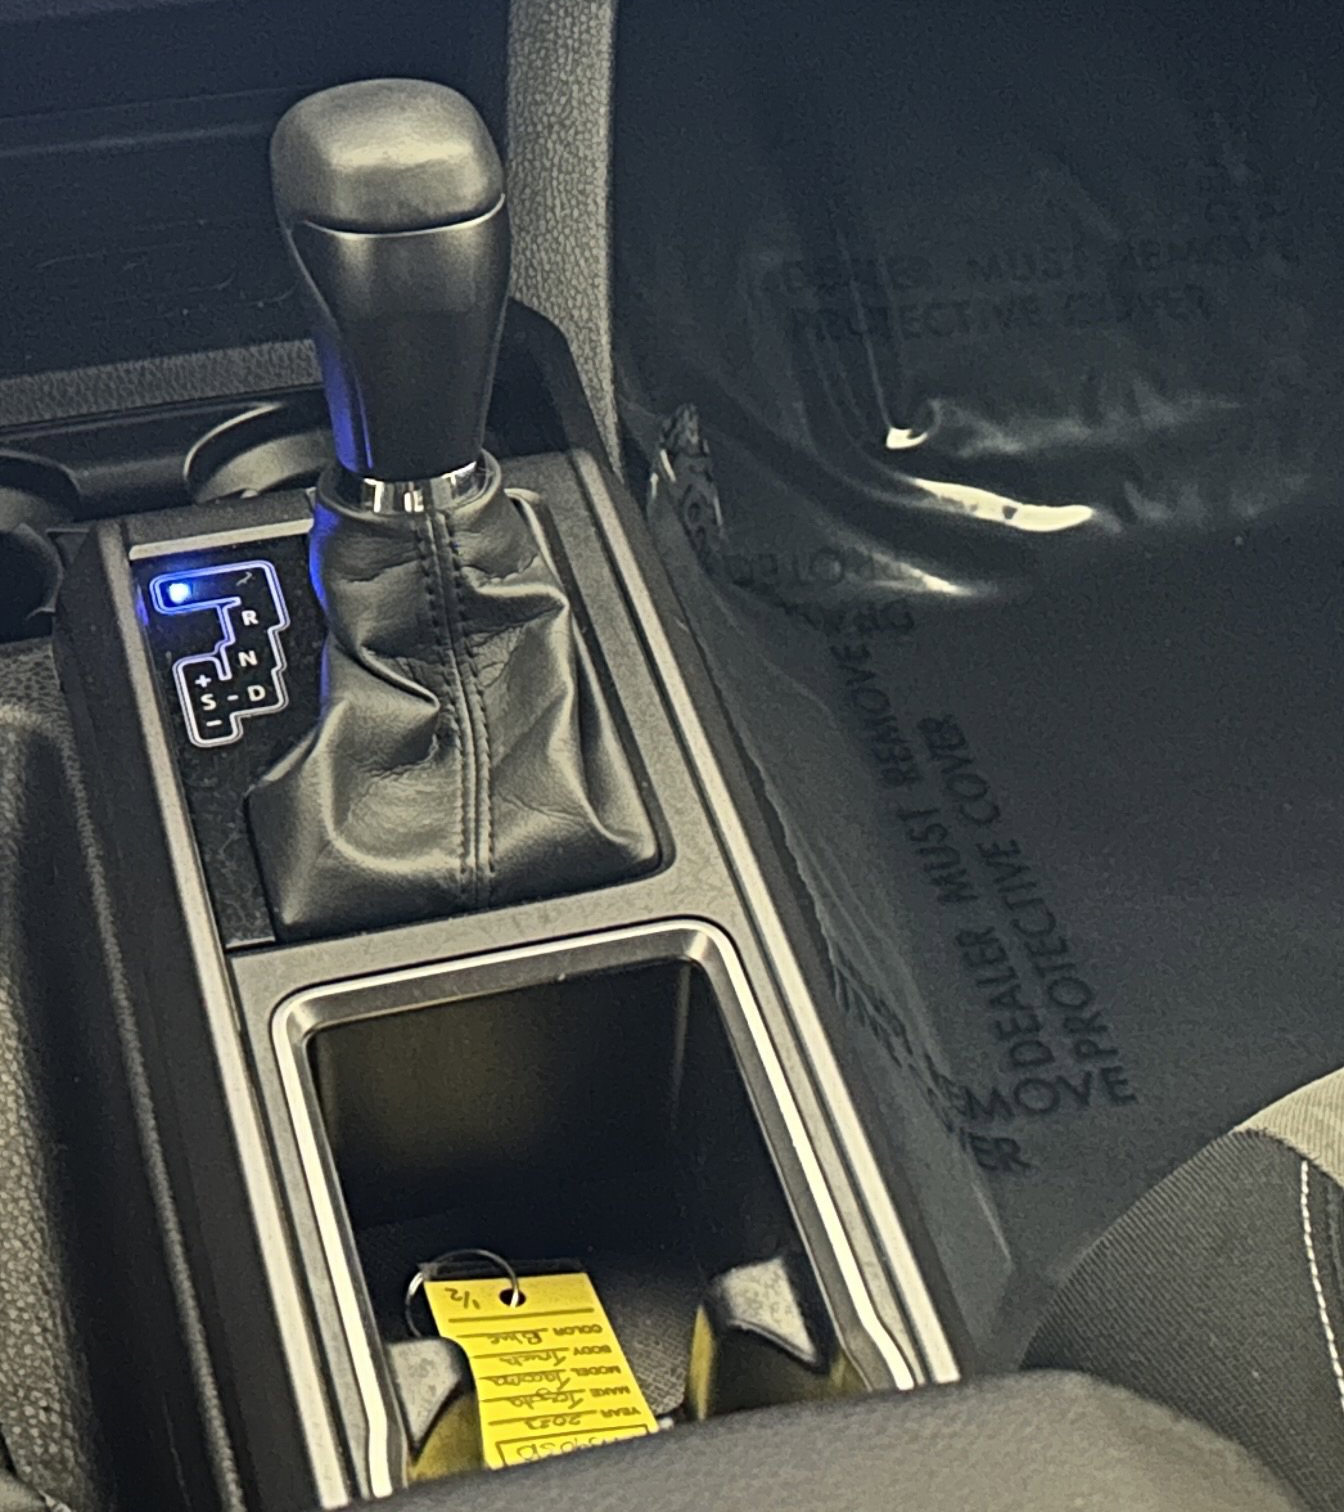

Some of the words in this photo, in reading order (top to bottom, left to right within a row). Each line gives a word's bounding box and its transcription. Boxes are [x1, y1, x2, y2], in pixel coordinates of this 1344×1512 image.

[242, 610, 259, 626] R
[238, 650, 258, 667] N
[830, 643, 923, 786] REMOVE
[917, 714, 1001, 825] COVER
[896, 808, 980, 904] MUST
[976, 838, 1119, 1060] PROTECTIVE
[956, 927, 1055, 1069] DEALER
[553, 1324, 602, 1335] COLOR
[573, 1345, 612, 1356] BODY
[571, 1365, 621, 1376] MODEL
[590, 1385, 631, 1396] MAKE
[601, 1407, 641, 1418] YEAR
